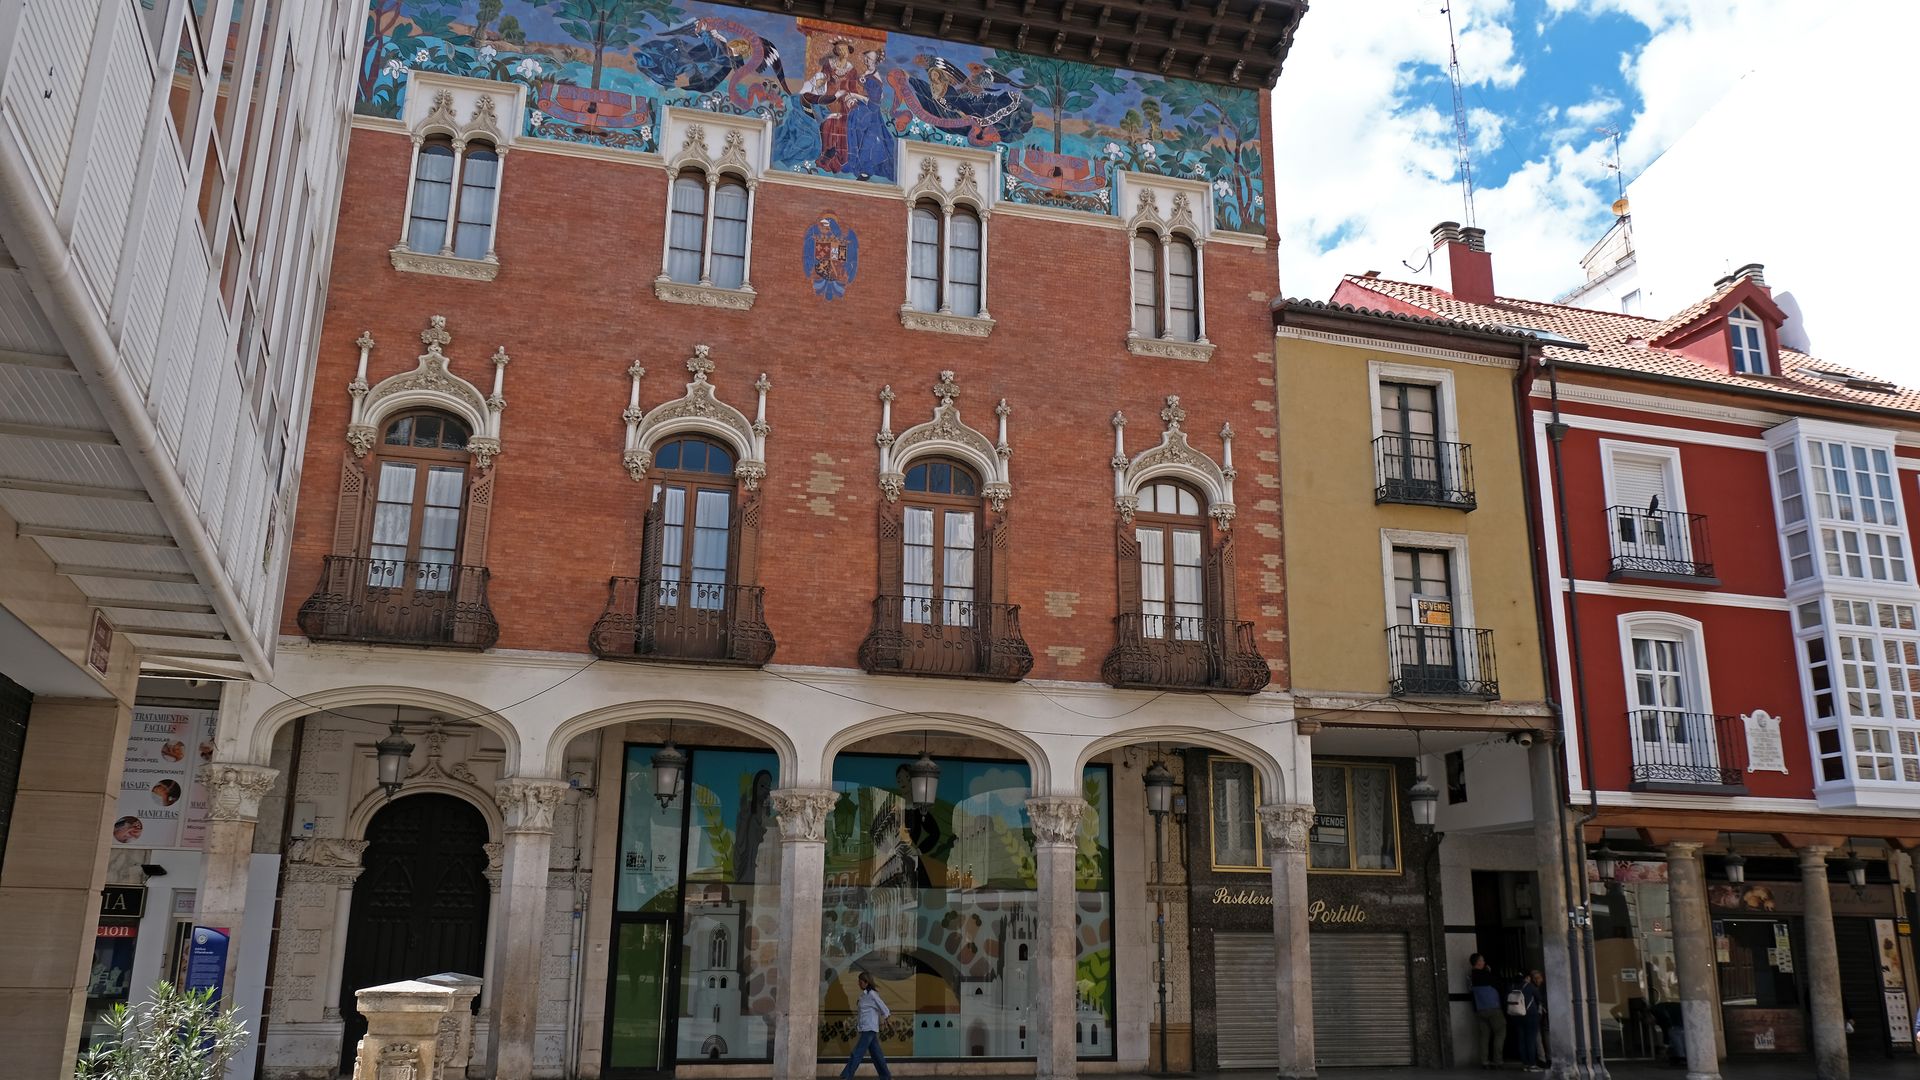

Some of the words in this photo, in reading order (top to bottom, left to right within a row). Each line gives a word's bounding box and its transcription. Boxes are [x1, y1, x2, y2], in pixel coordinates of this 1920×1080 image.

[1419, 601, 1428, 610] SE
[1428, 602, 1451, 612] VENDE
[1320, 816, 1345, 827] VENDE
[1308, 899, 1367, 924] Portillo
